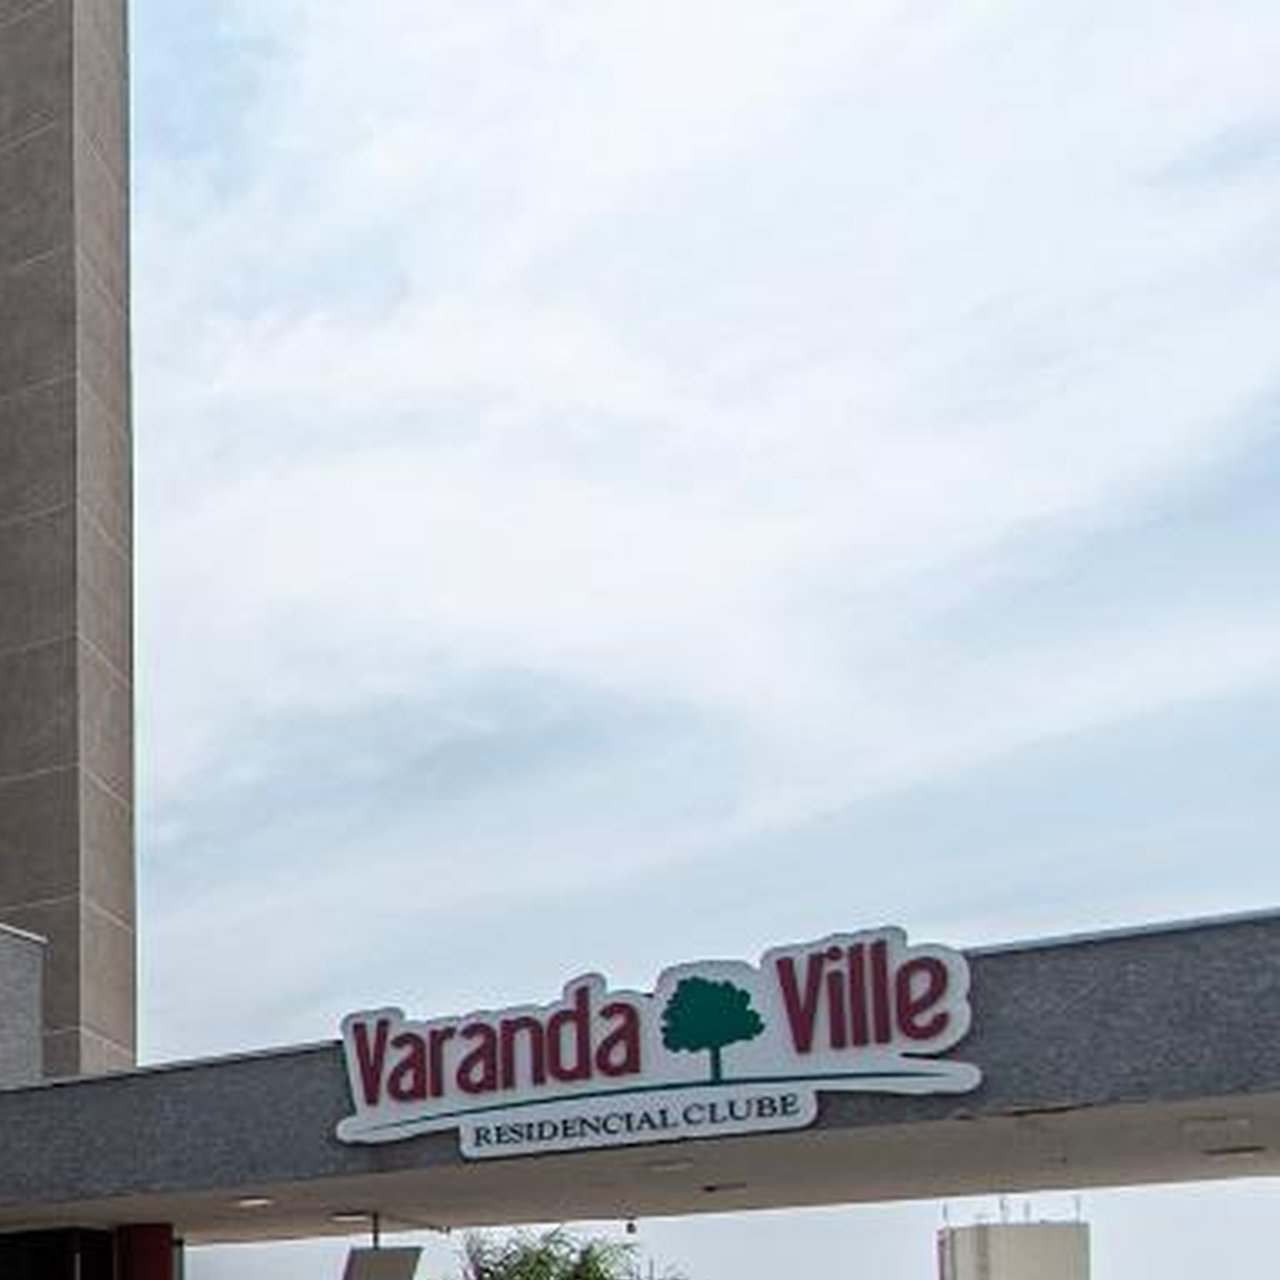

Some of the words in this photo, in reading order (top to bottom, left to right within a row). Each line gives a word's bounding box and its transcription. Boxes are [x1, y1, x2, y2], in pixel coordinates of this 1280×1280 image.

[352, 988, 640, 1107] Varanda
[776, 940, 949, 1054] Ville
[474, 1109, 678, 1146] RESIDENCIAL
[683, 1094, 799, 1125] CLUBE
